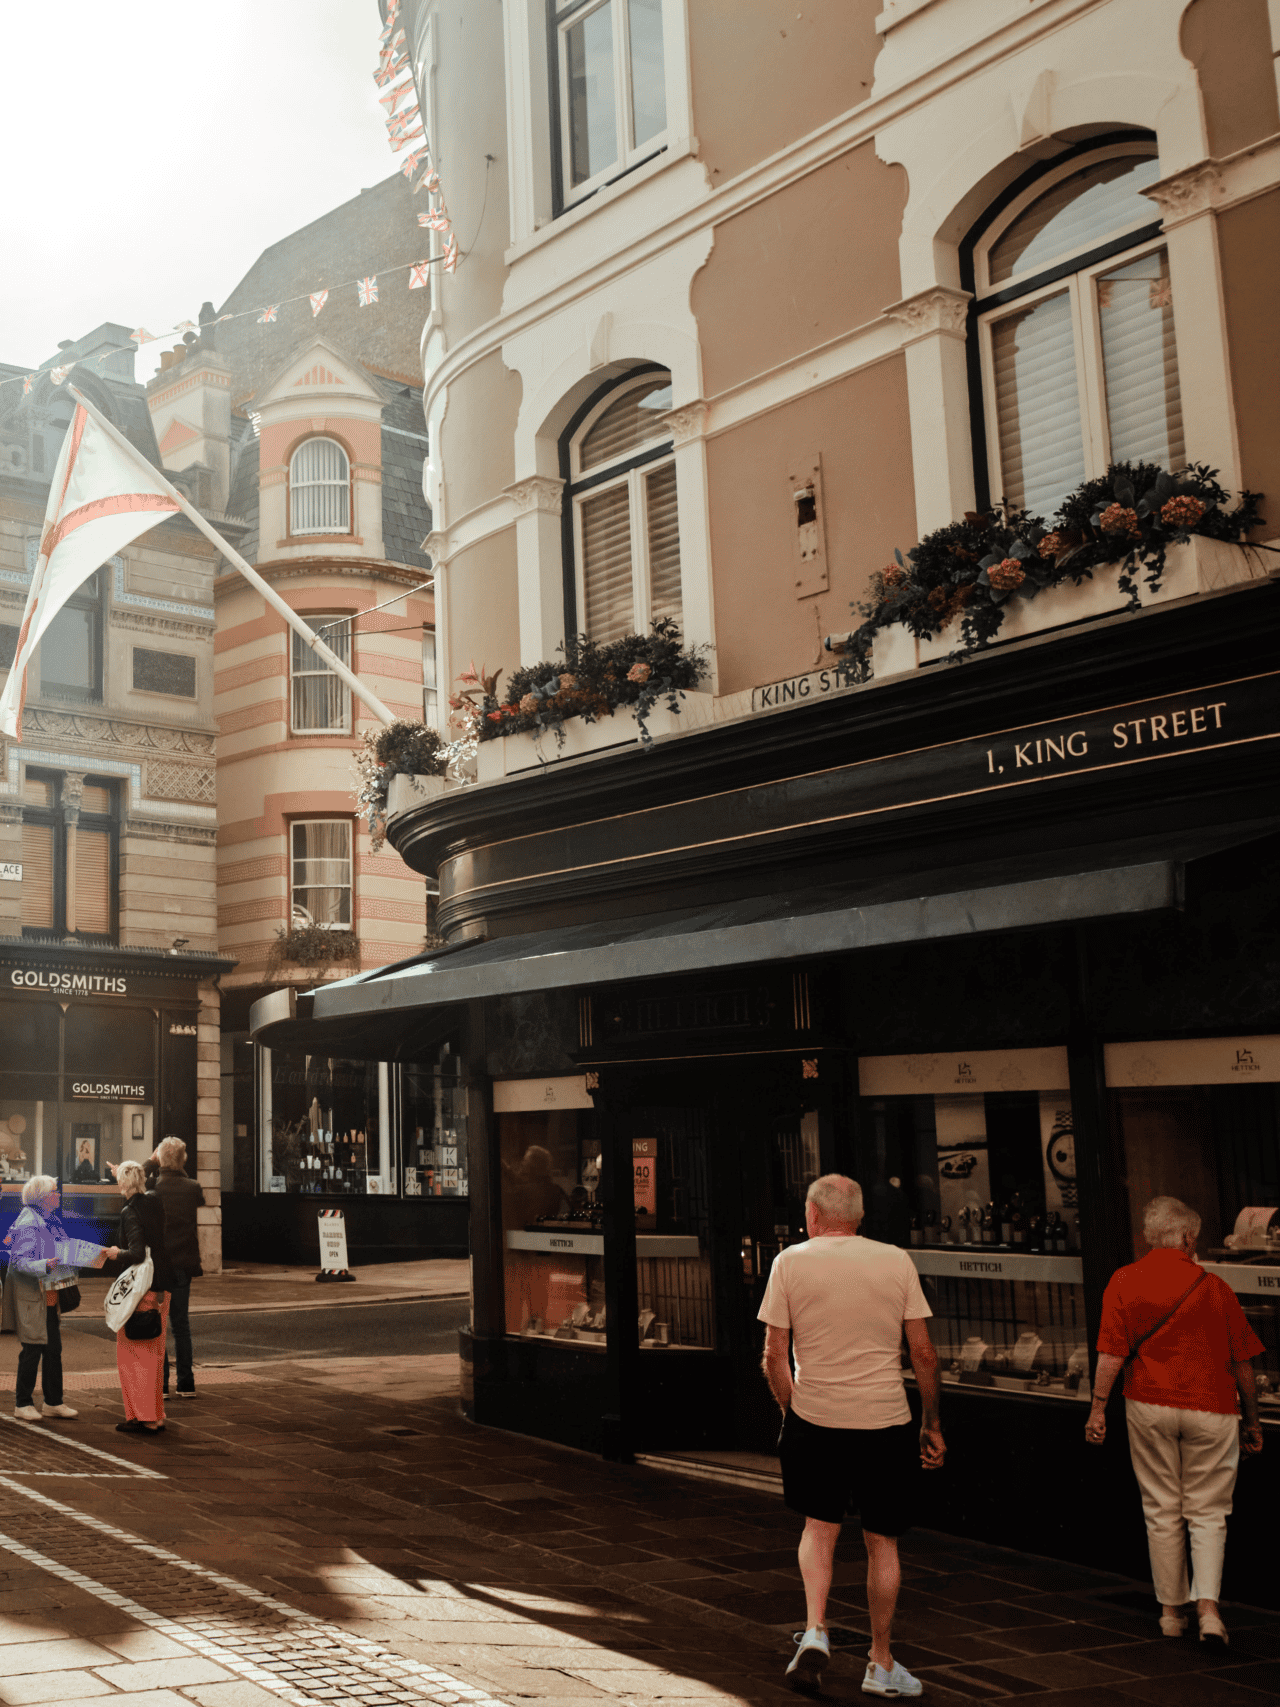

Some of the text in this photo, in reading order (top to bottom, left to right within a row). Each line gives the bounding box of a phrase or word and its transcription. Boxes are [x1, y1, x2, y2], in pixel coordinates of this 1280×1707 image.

[761, 677, 810, 708] KING
[986, 702, 1227, 774] 1, KING STREET
[11, 969, 127, 993] GOLDSMITHS
[53, 987, 73, 995] SINCE
[72, 1082, 145, 1096] GOLDSMITHS
[549, 1239, 574, 1248] HETTICH
[959, 1261, 1002, 1272] HETTICH
